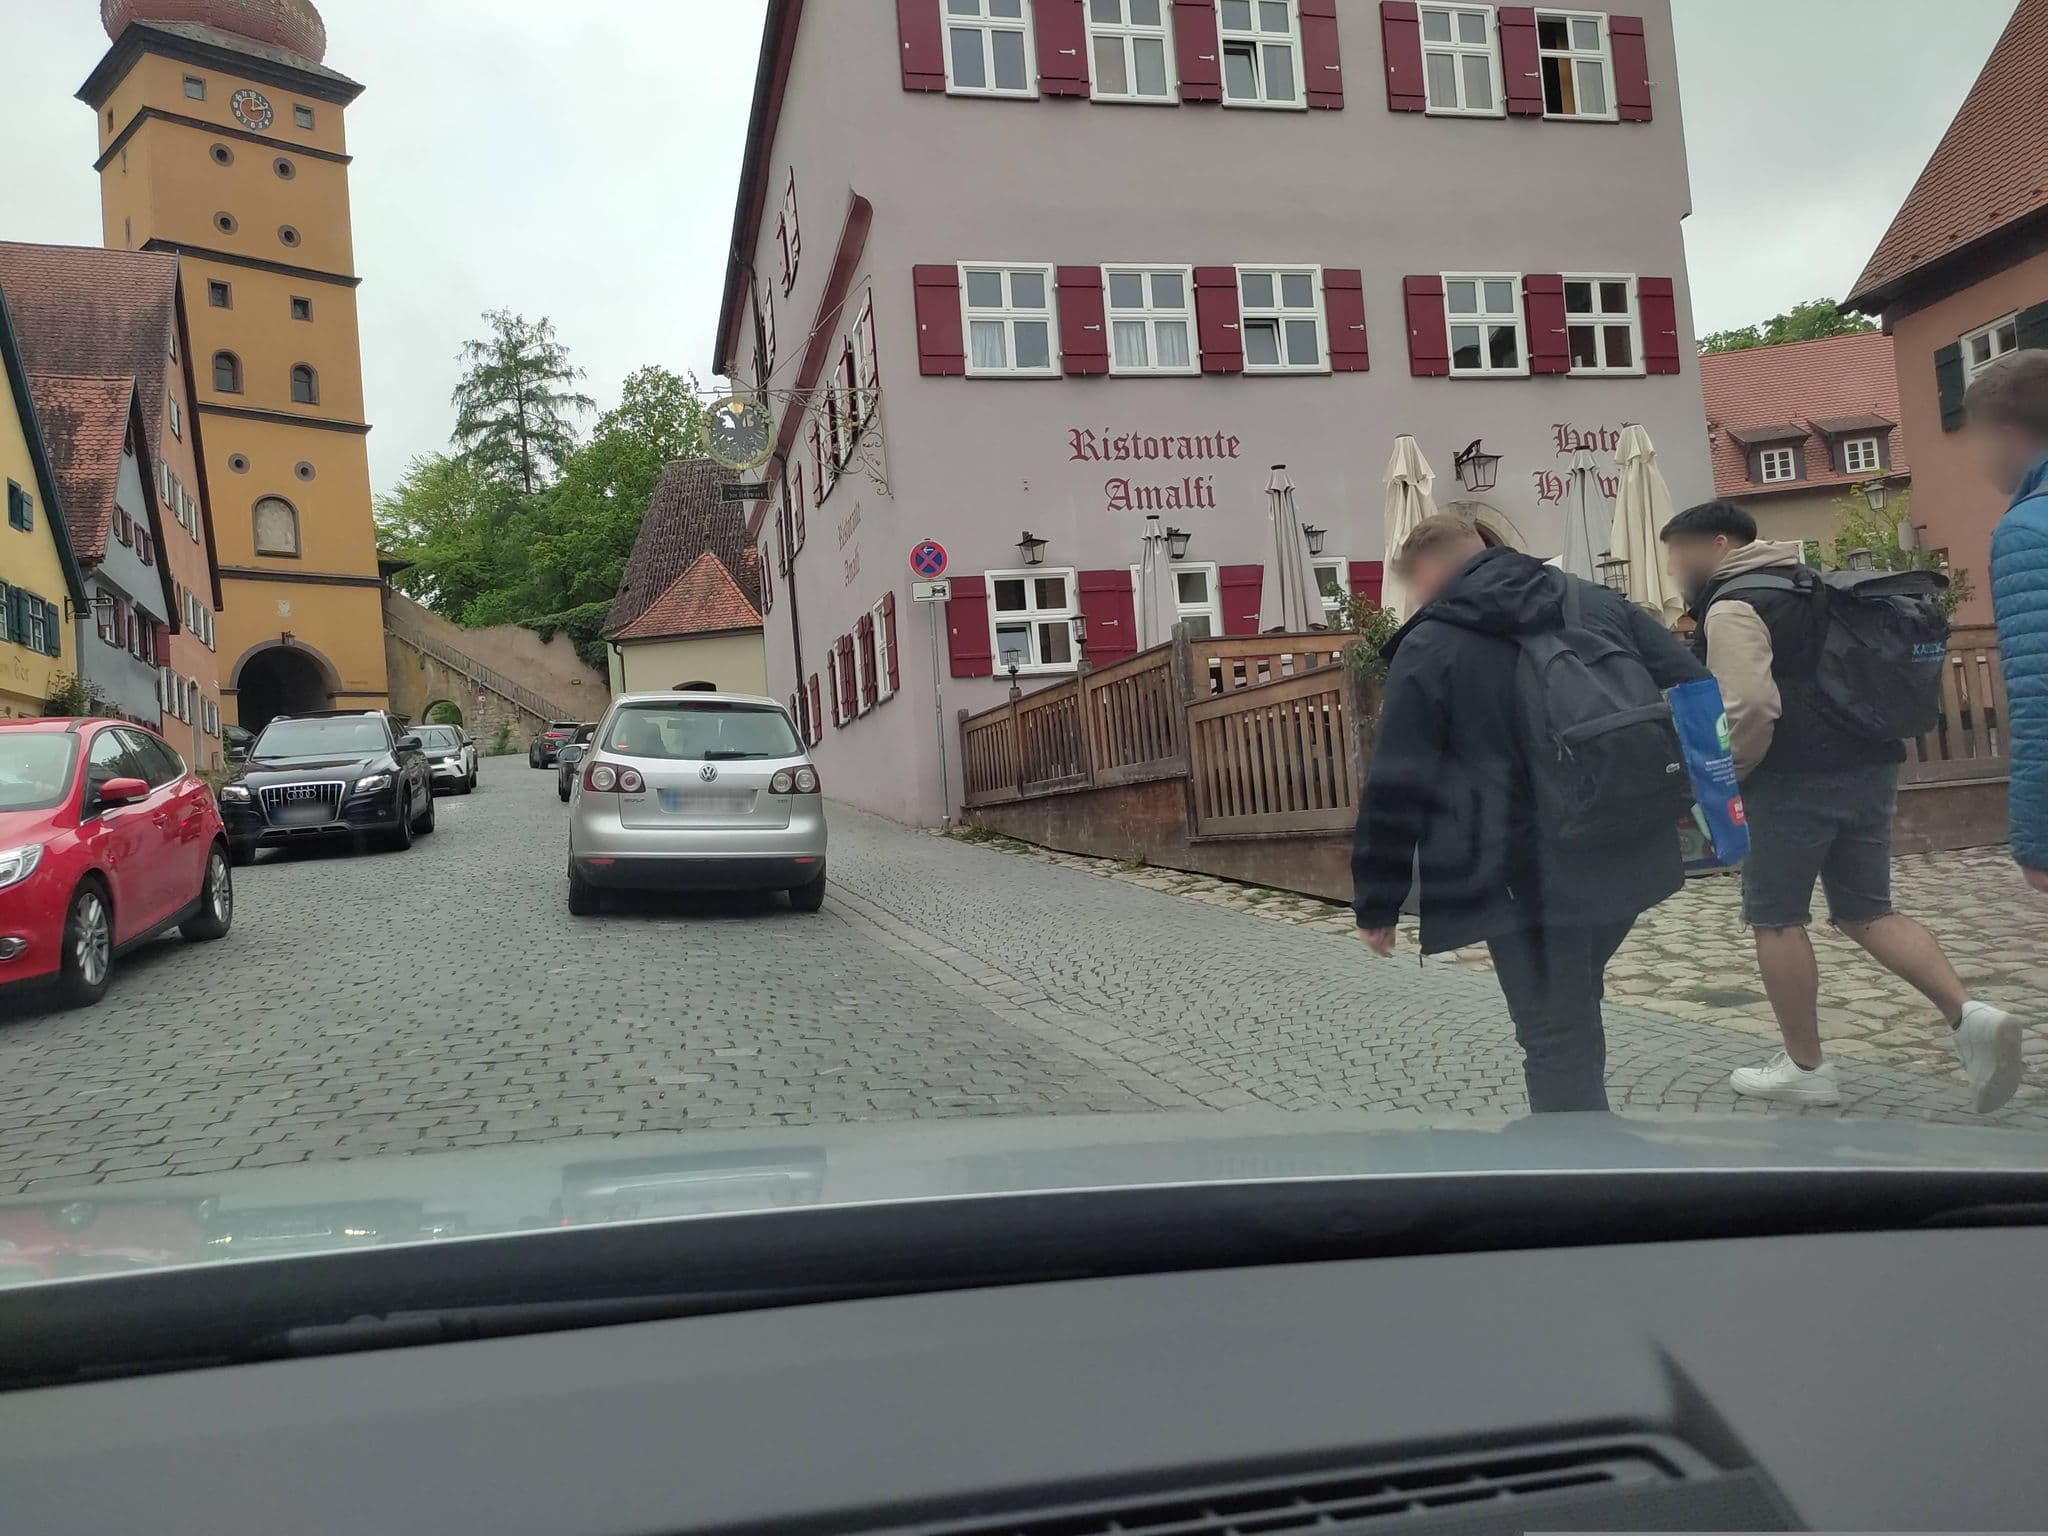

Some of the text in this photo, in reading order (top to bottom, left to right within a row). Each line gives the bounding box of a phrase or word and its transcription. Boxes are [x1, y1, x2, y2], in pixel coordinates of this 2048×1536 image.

[1068, 427, 1240, 462] Ristorante
[1551, 422, 1623, 458] Hote
[1105, 476, 1216, 511] Amalfi
